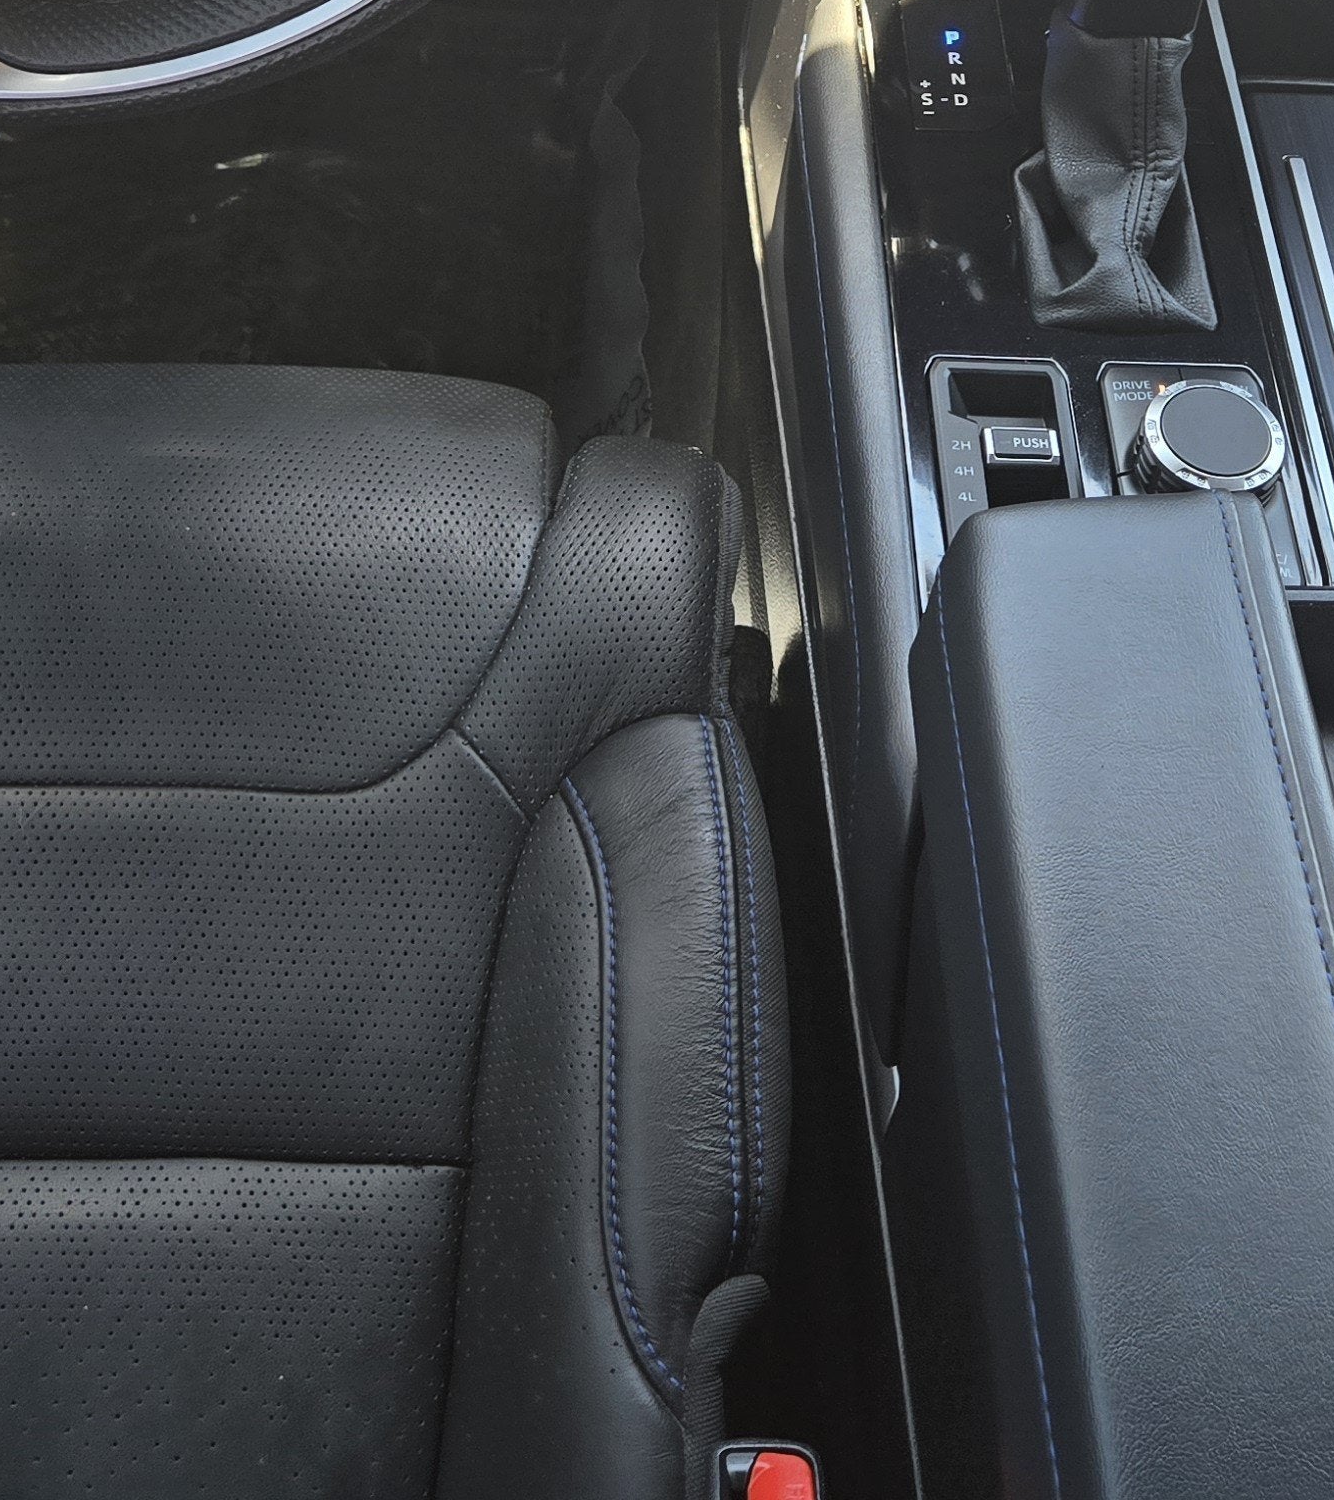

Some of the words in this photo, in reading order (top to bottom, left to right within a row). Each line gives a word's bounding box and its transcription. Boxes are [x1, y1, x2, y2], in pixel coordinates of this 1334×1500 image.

[944, 30, 960, 46] P
[947, 51, 963, 65] R
[950, 73, 966, 86] N
[920, 92, 934, 106] S
[953, 93, 969, 106] D
[1111, 380, 1152, 391] DRIVE
[1113, 391, 1154, 402] MODE
[951, 439, 972, 451] 2H
[1012, 437, 1050, 449] PUSH
[953, 465, 975, 477] 4H
[957, 491, 977, 503] 4L
